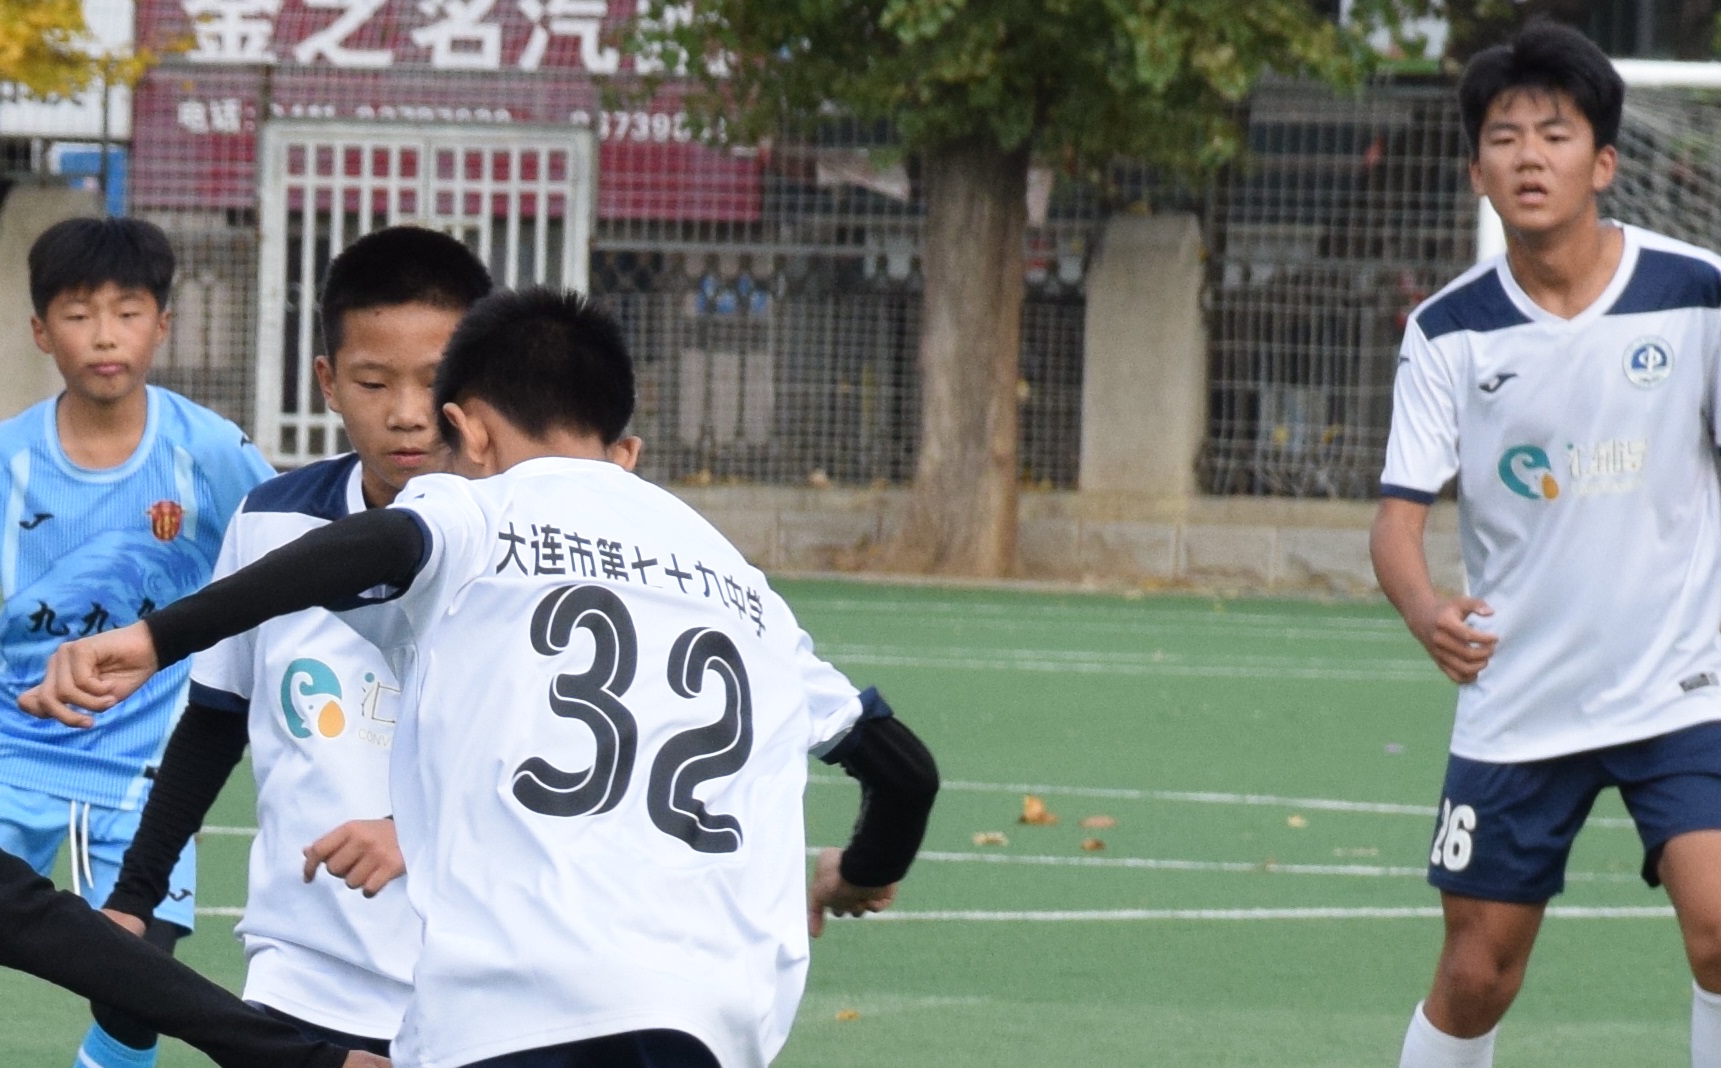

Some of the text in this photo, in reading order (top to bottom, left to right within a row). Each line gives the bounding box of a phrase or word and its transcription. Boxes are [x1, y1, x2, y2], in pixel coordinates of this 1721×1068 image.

[496, 522, 768, 638] 大连市第七十九中学
[512, 584, 755, 854] 32
